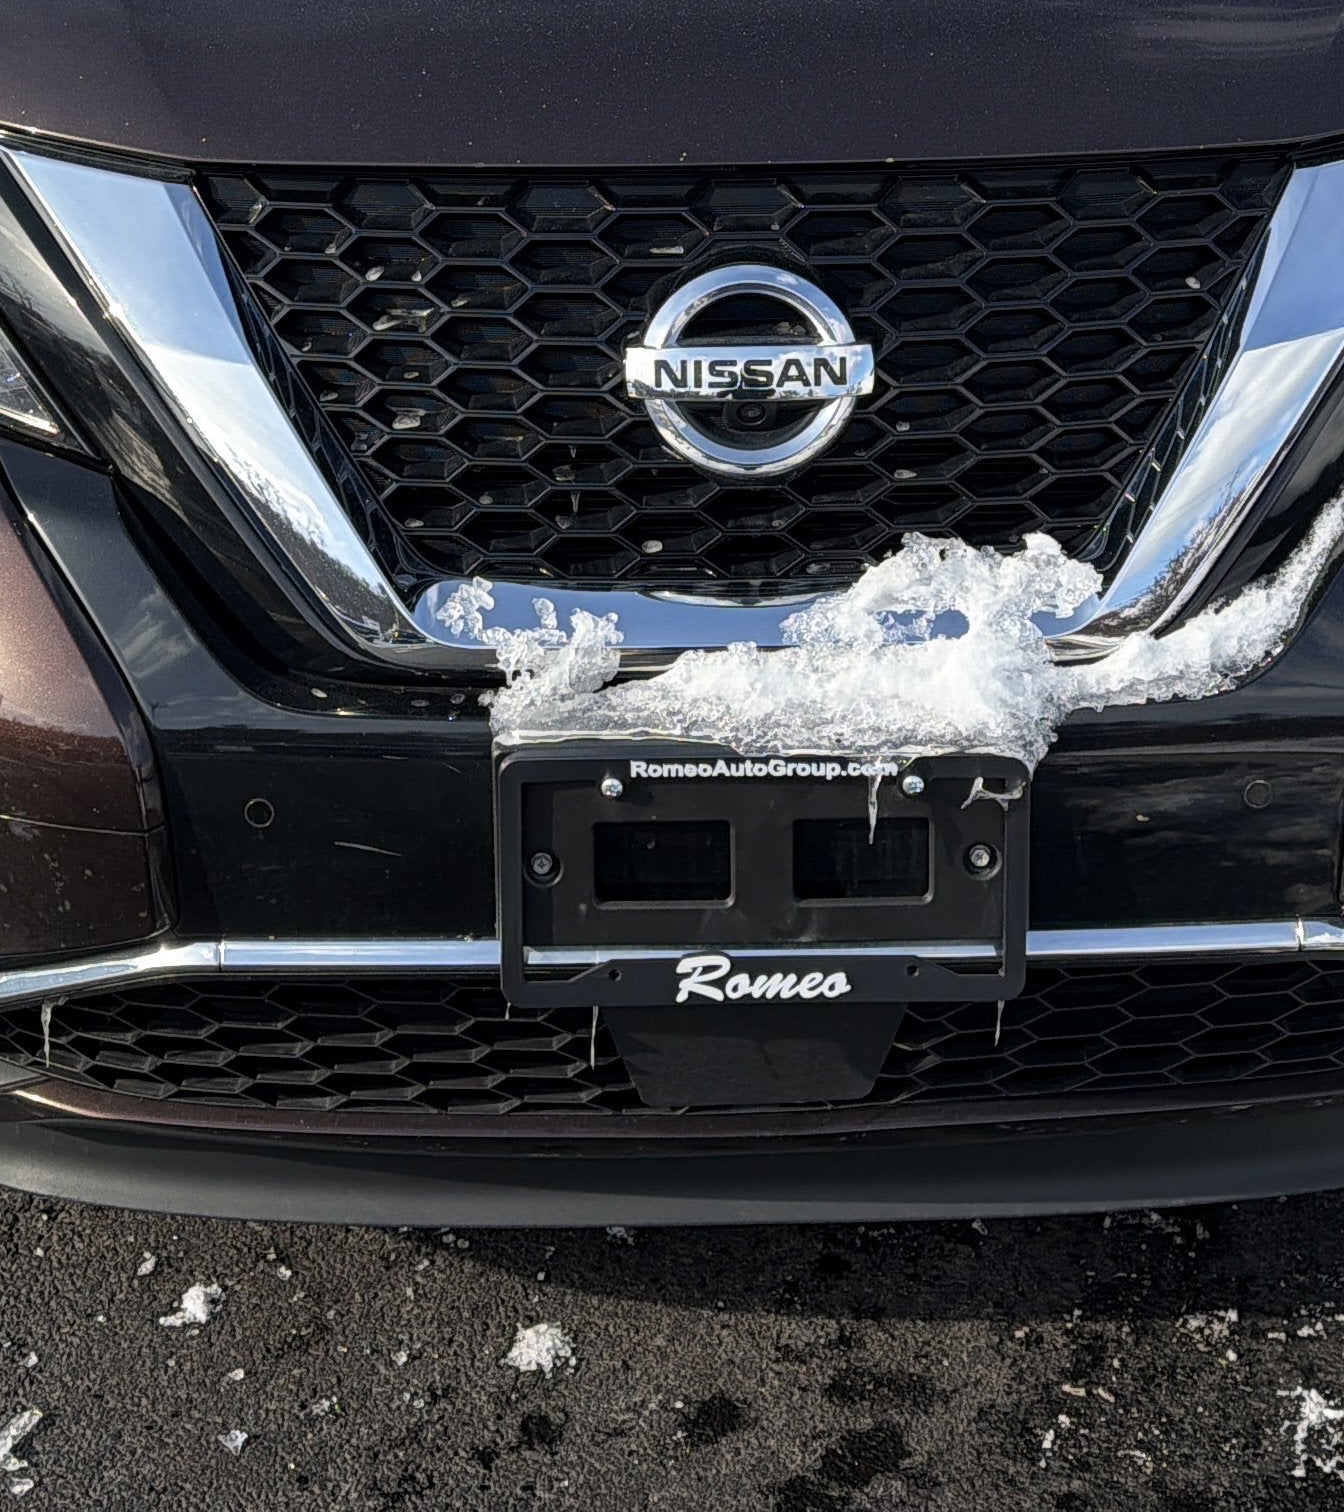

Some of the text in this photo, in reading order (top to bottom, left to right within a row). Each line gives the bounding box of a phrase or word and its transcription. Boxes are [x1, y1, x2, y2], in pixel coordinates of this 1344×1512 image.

[653, 356, 848, 389] NISSAN
[630, 759, 899, 781] RomeoAutoGroup.com
[675, 954, 852, 1004] Romeo
